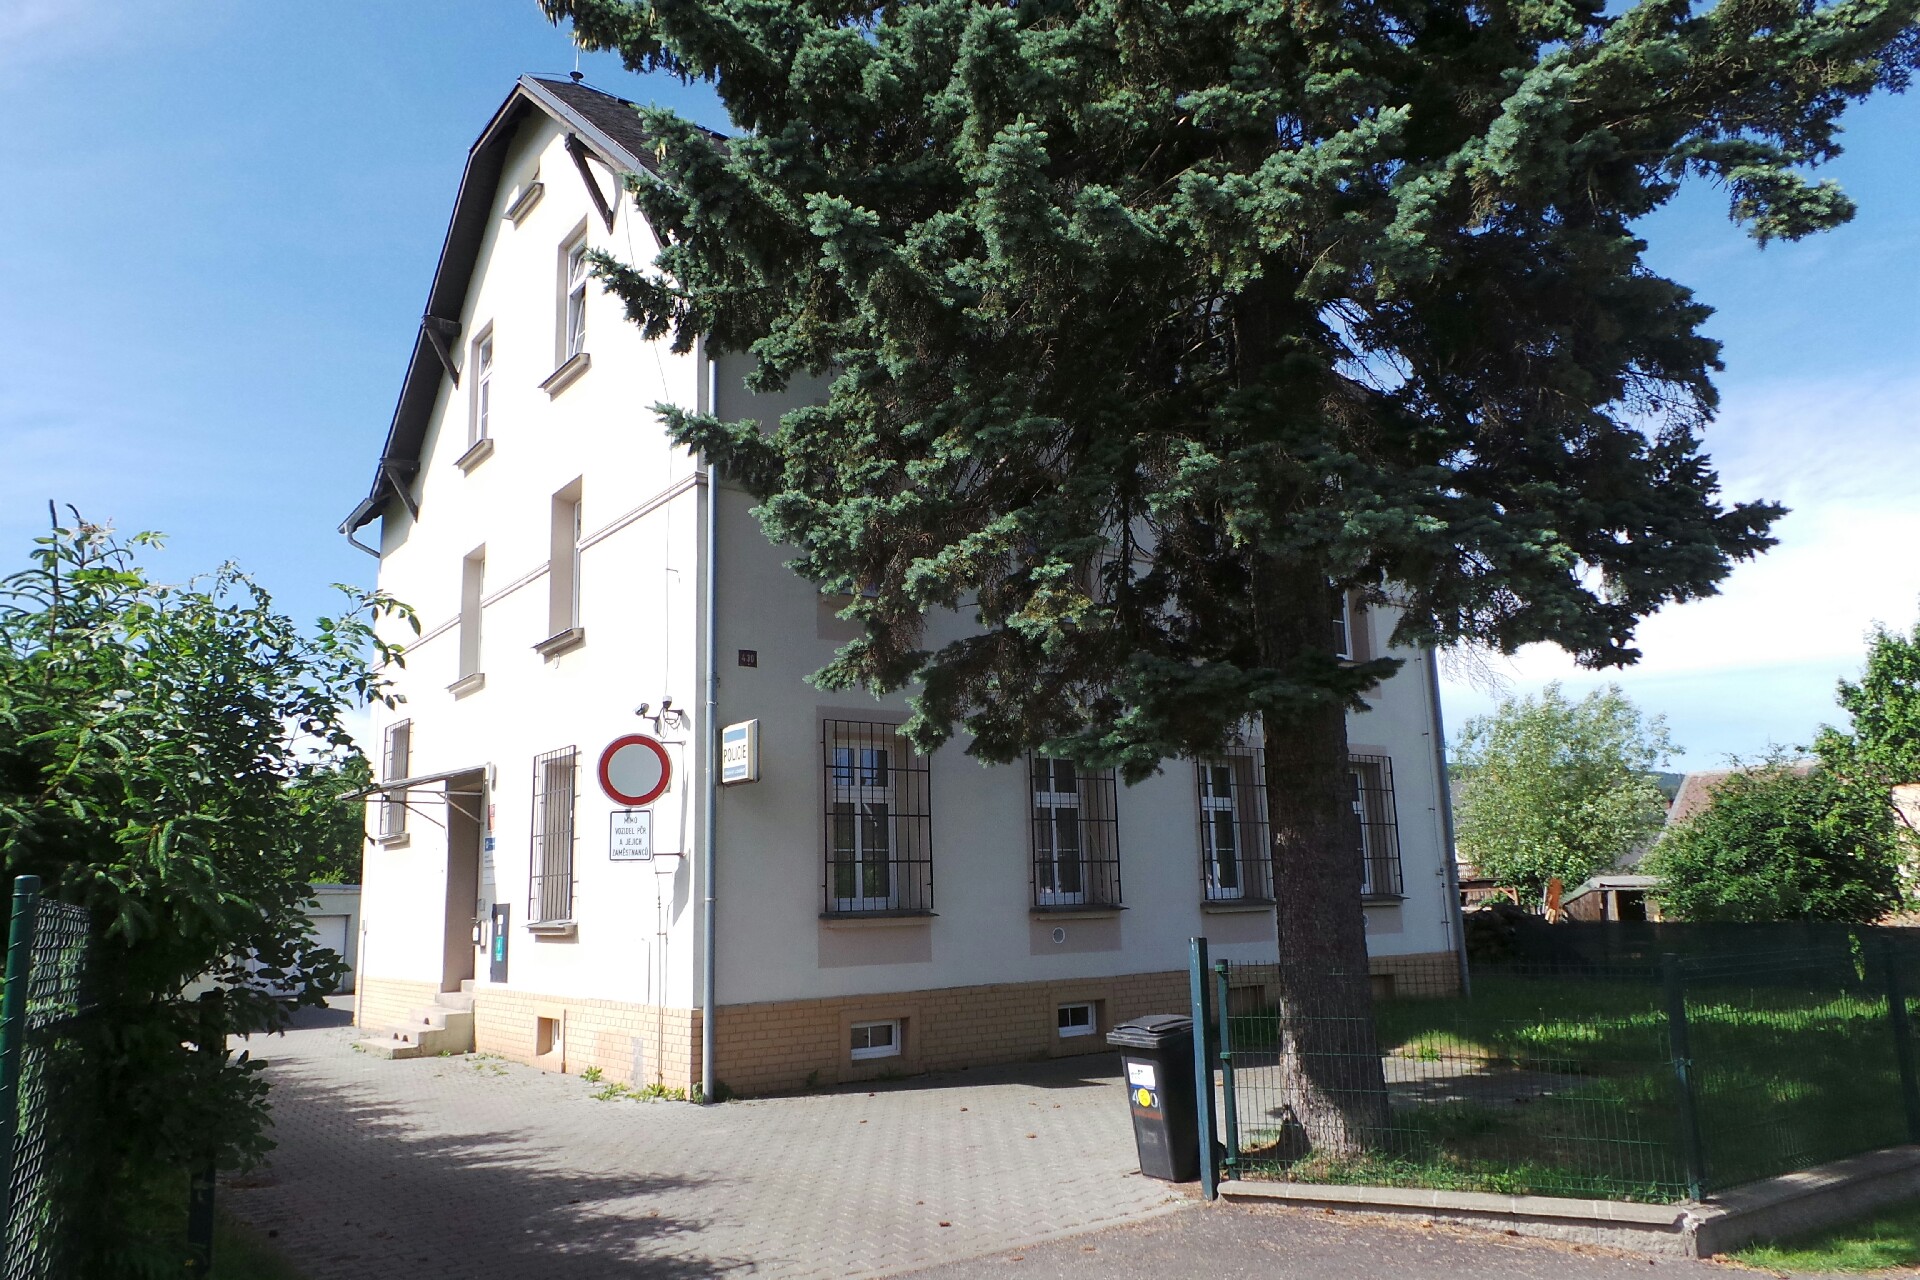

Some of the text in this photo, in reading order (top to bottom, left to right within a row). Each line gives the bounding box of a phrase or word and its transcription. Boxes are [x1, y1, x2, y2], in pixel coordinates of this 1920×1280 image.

[723, 744, 747, 764] POLICIE
[623, 816, 638, 824] MIMO
[615, 825, 647, 835] VOZIDEL PČR
[625, 838, 642, 846] JEJICH
[612, 847, 649, 857] ZAMĚSTNANCŮ
[1132, 1089, 1158, 1108] 40
